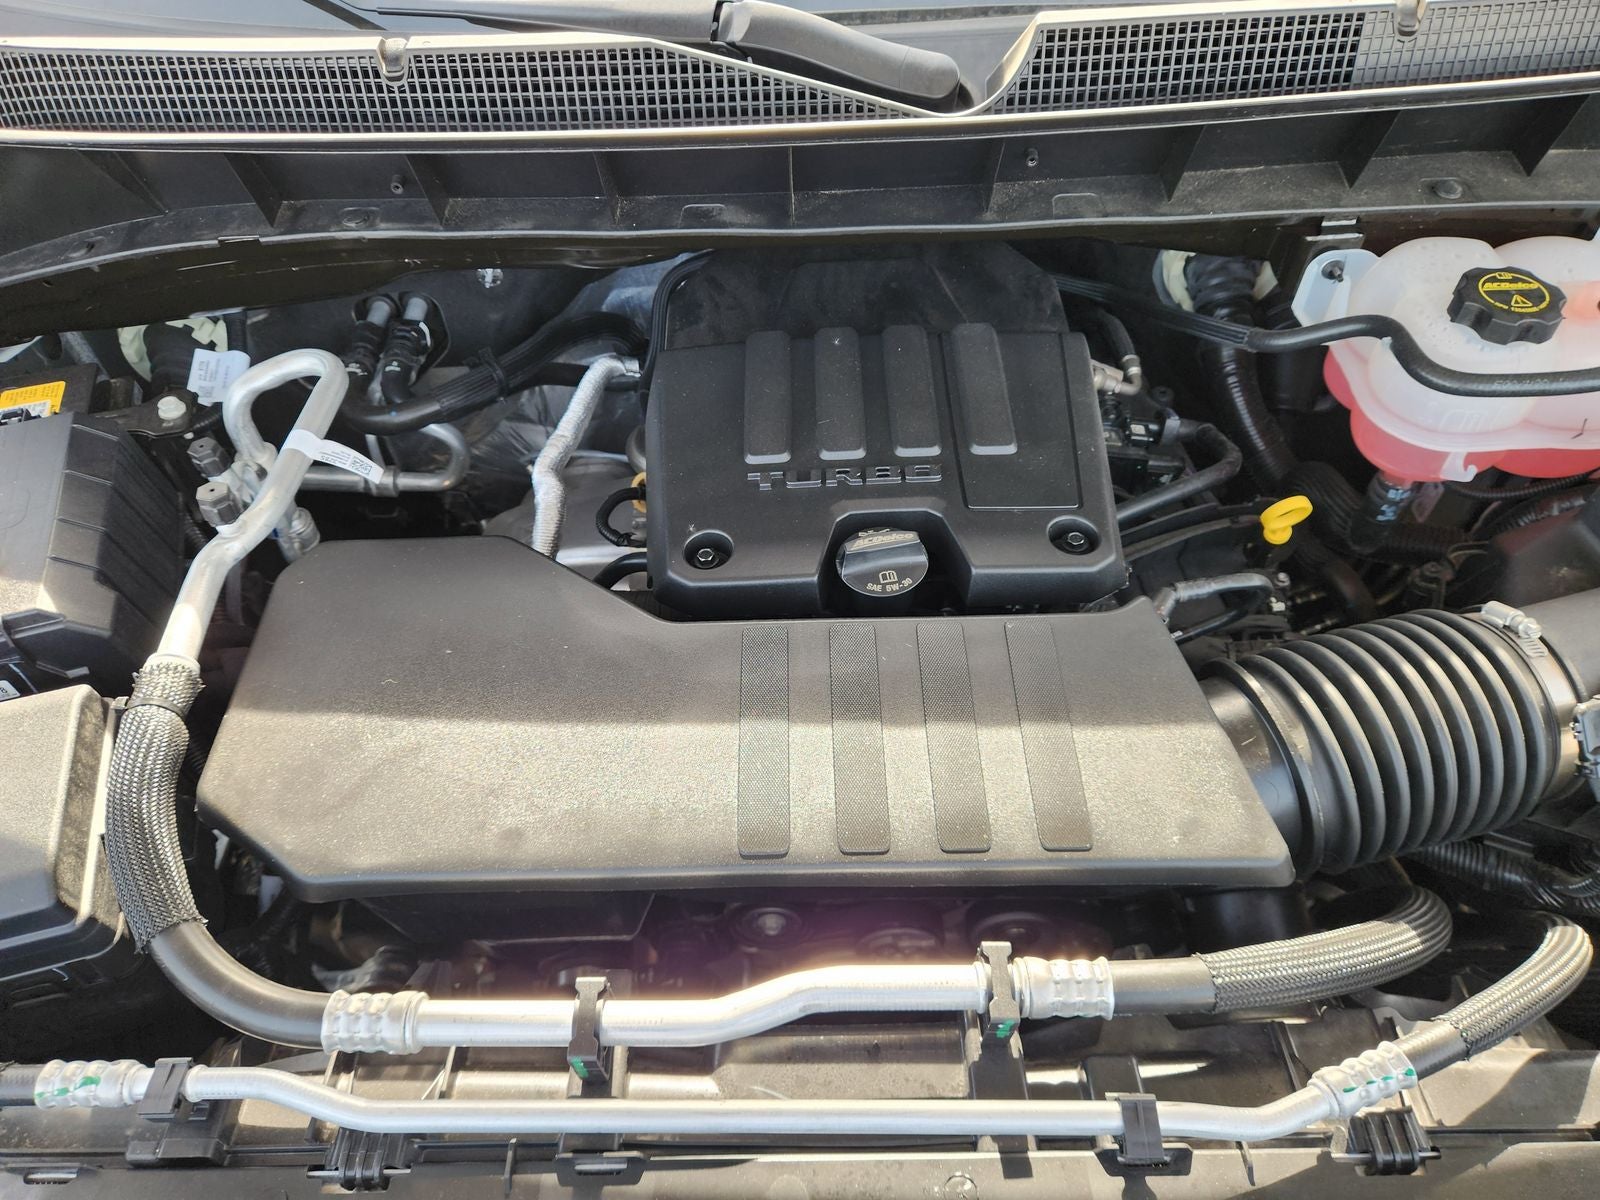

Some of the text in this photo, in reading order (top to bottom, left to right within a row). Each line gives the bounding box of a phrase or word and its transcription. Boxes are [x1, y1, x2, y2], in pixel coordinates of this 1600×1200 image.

[747, 465, 942, 491] TURBO
[866, 577, 913, 592] SAE 5W-30
